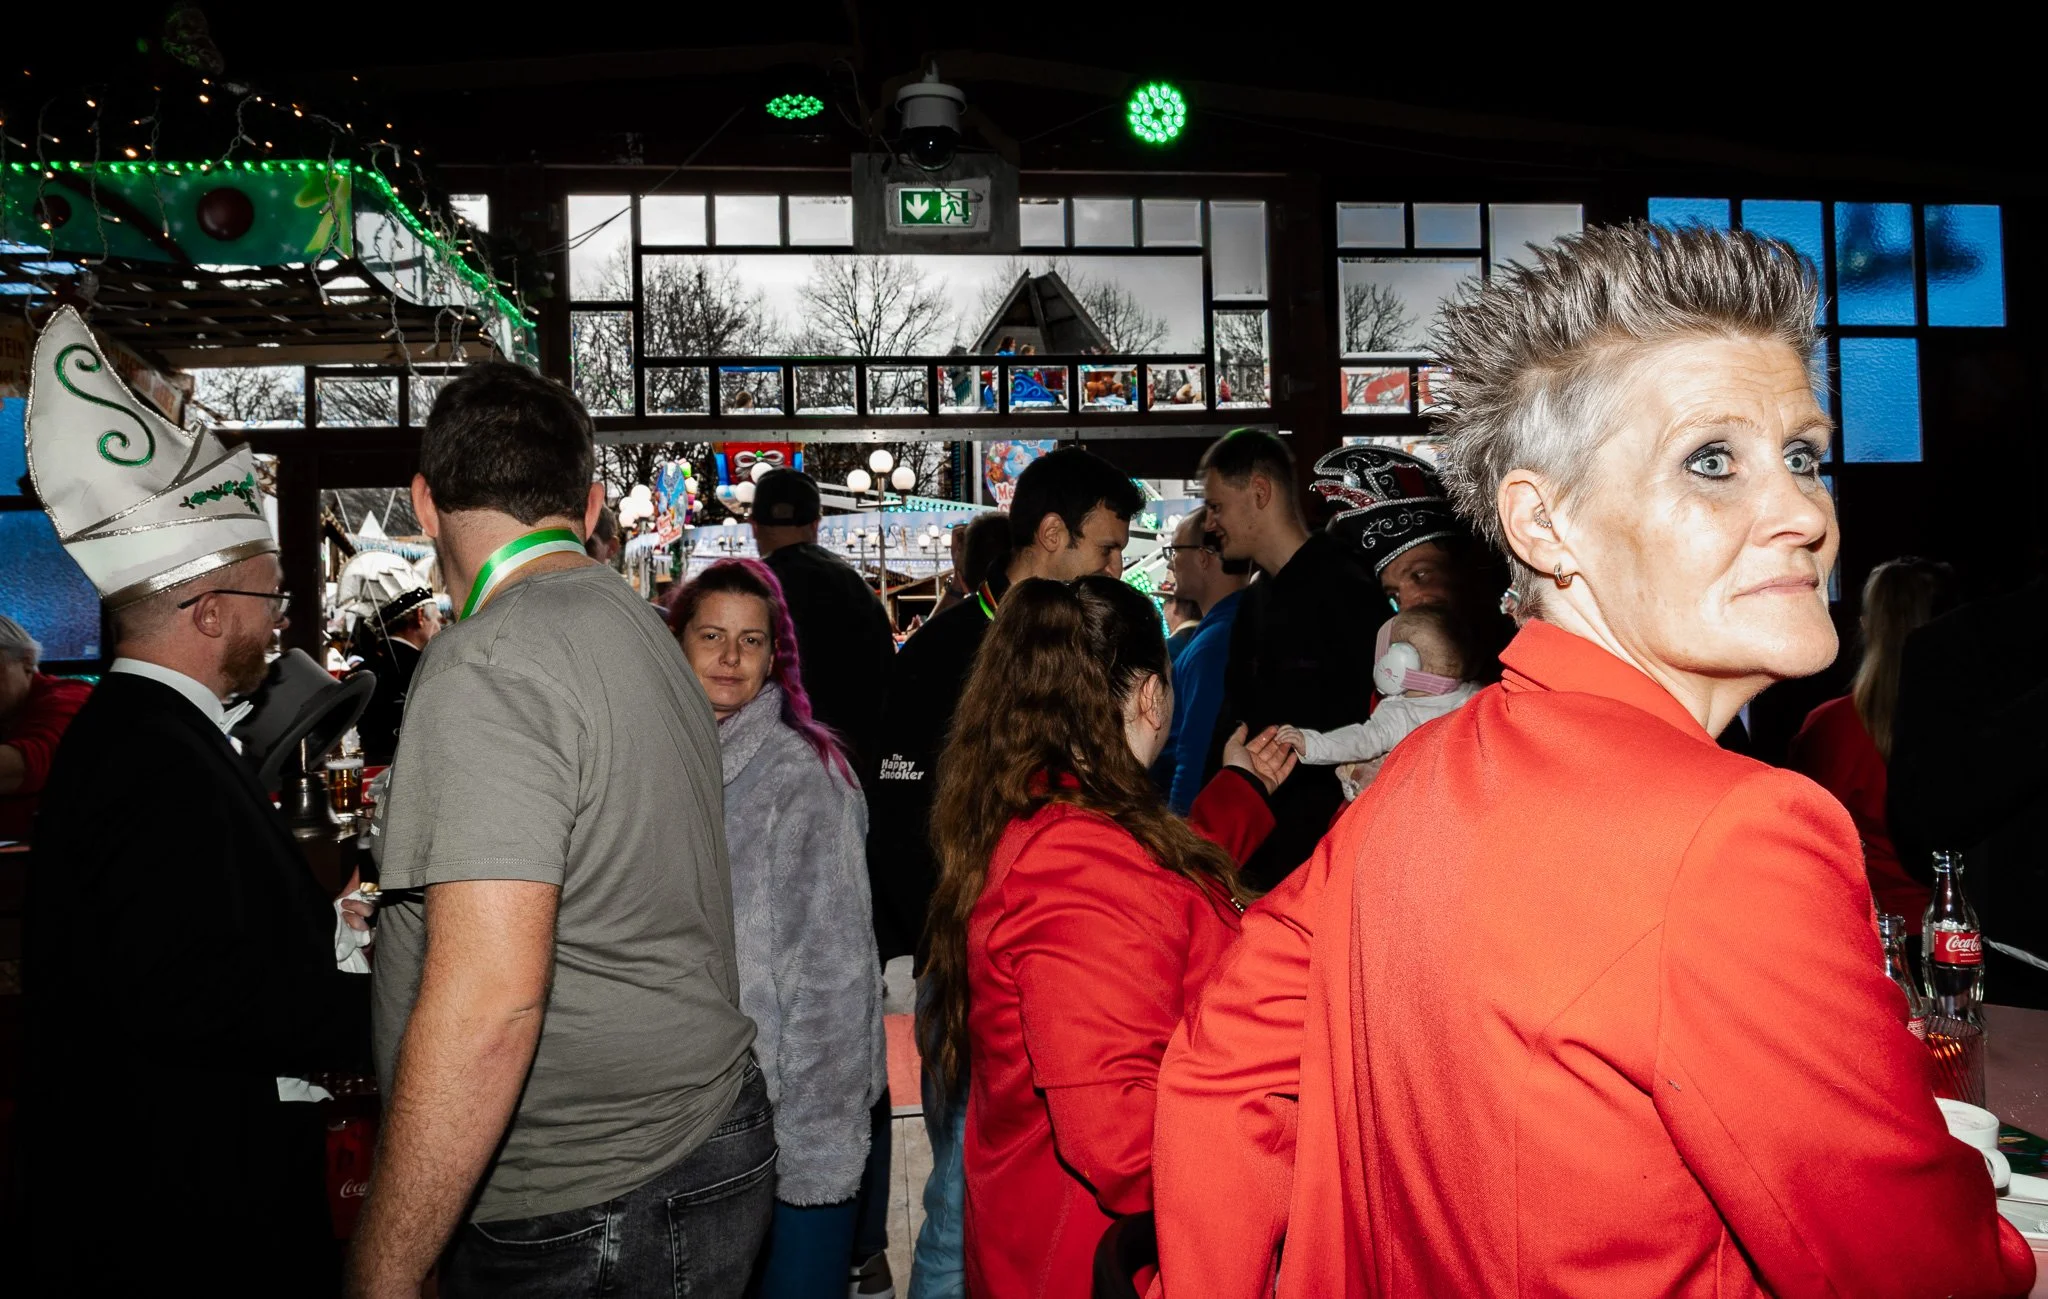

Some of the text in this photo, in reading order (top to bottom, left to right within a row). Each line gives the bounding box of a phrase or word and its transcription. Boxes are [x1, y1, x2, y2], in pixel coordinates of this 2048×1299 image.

[892, 753, 903, 761] The
[881, 758, 915, 771] Happy
[879, 769, 924, 780] Snooker
[340, 1179, 367, 1198] Coca
